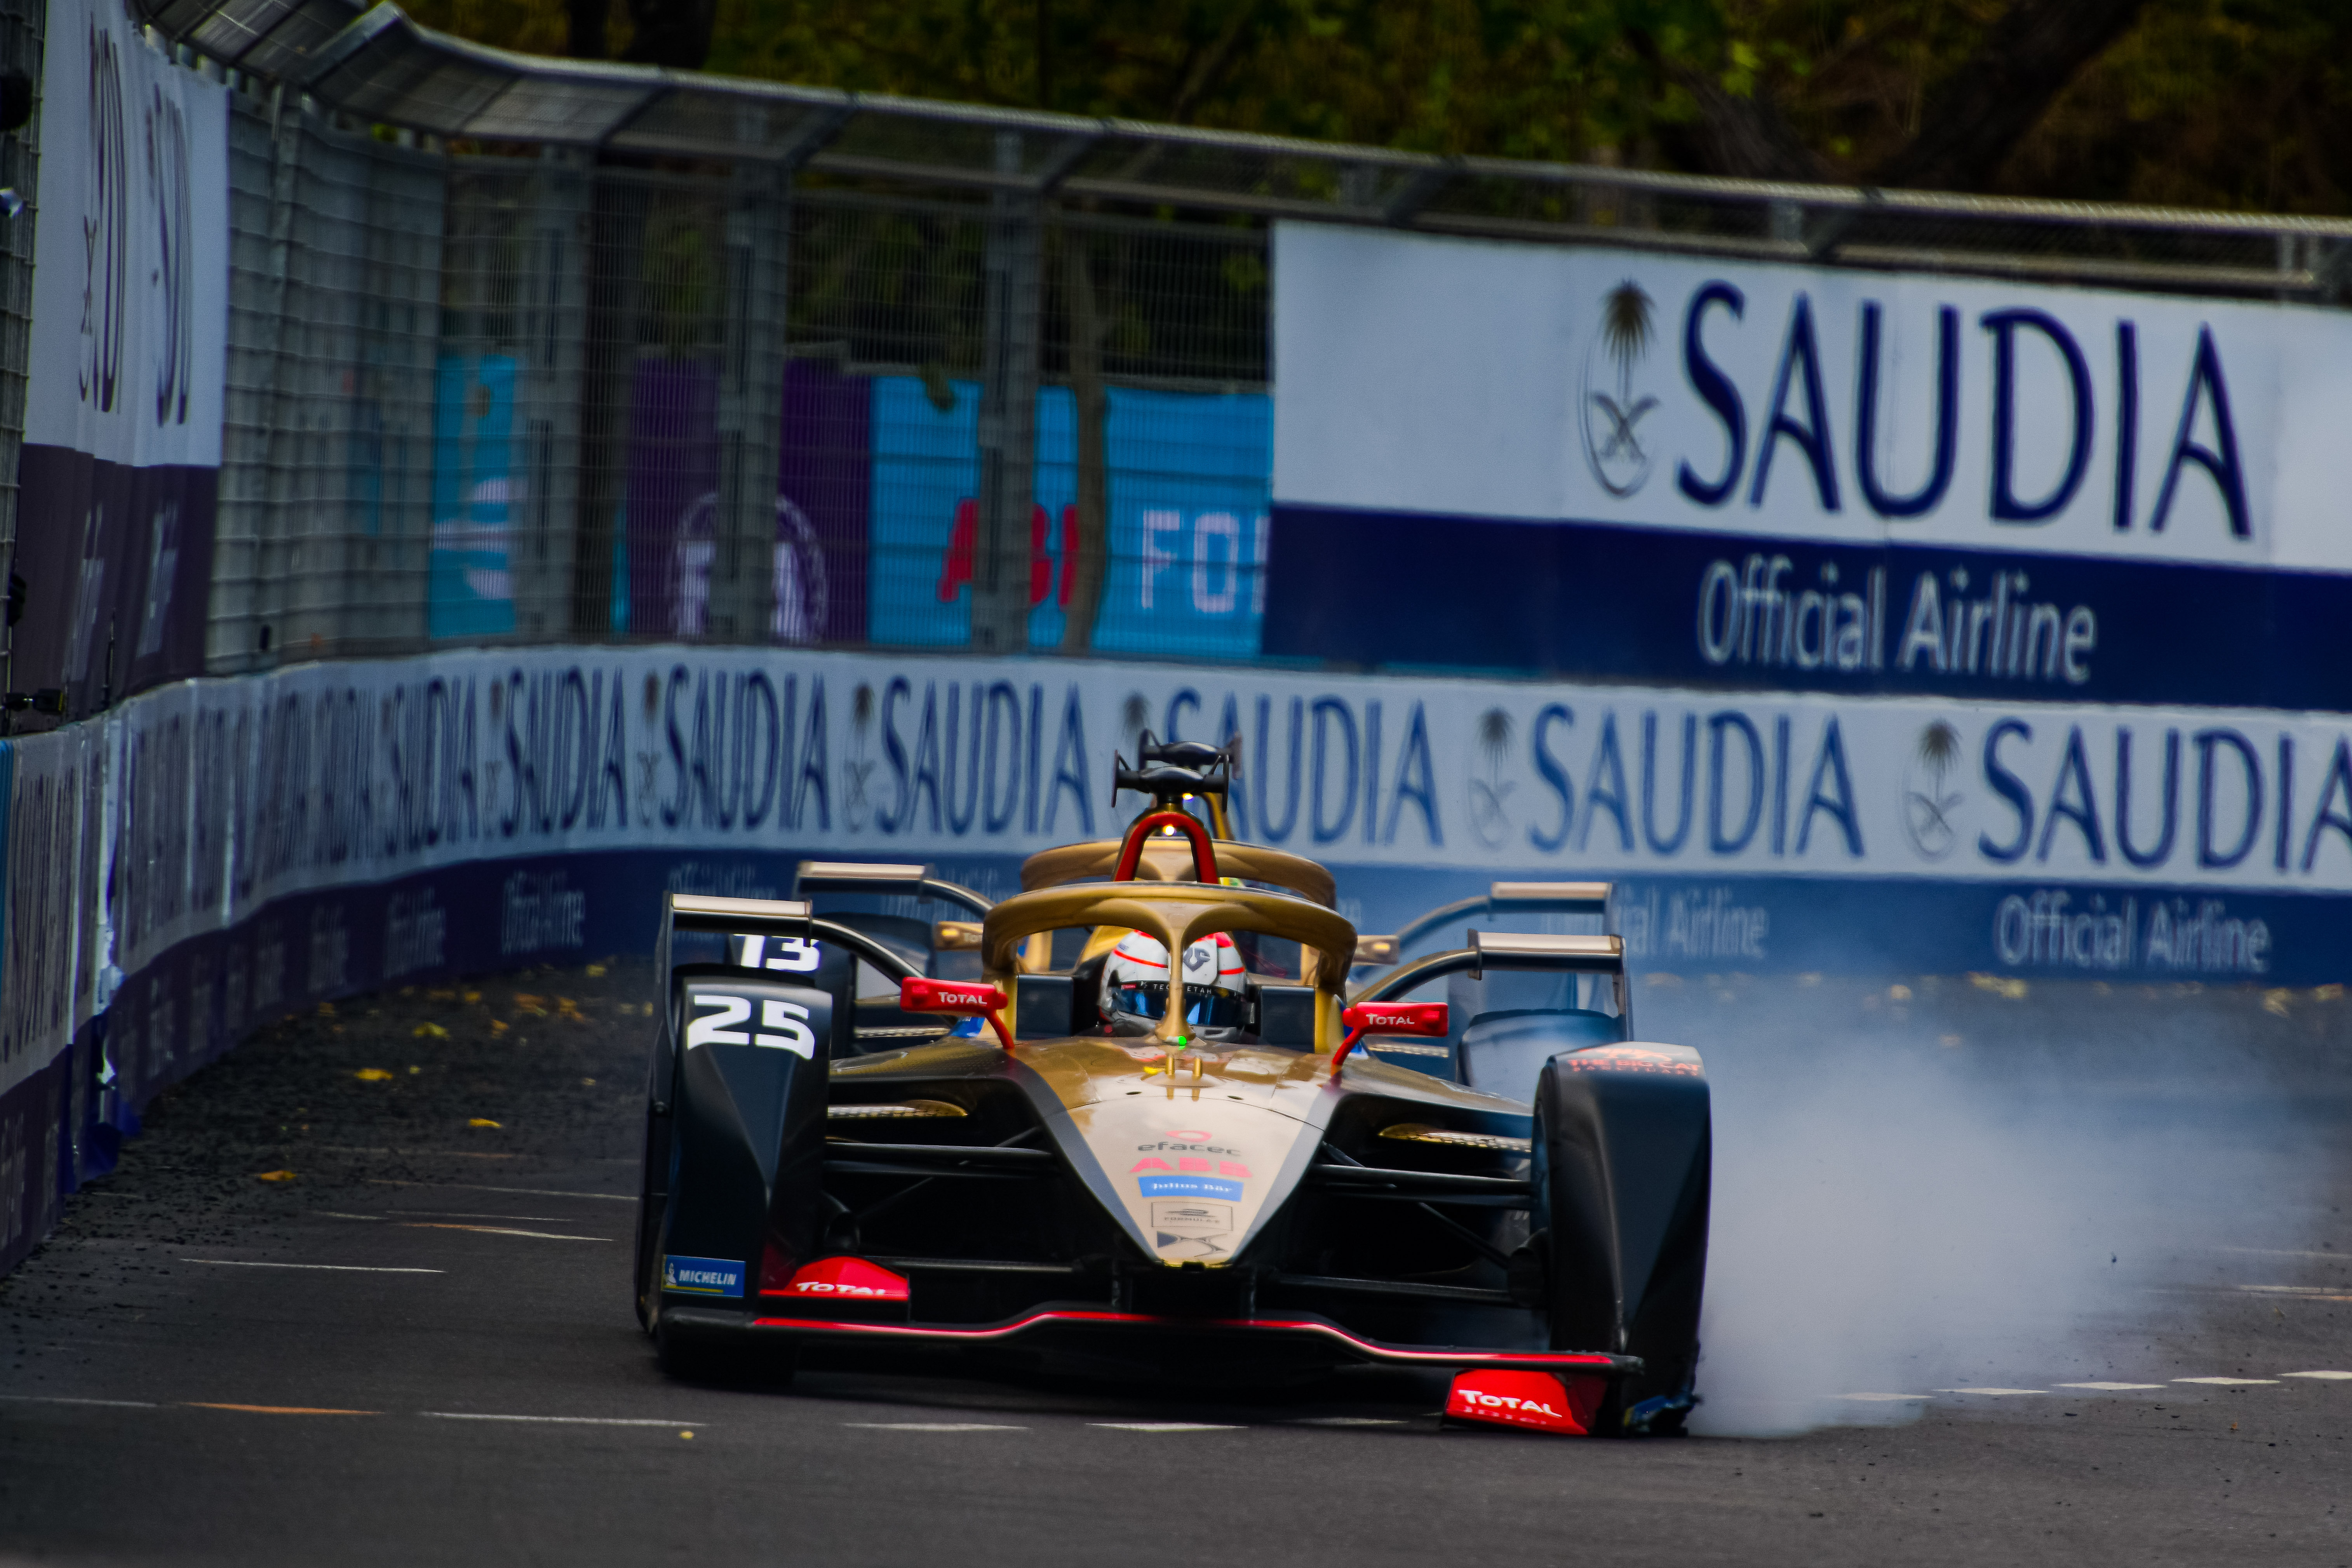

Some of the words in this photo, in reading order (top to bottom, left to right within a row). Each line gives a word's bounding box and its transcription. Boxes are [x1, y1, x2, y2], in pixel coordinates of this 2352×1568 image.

[1675, 278, 2252, 539] SAUDIA
[1698, 553, 1886, 671] Official
[1896, 568, 2097, 684] Airline
[662, 663, 830, 833] SAUDIA
[876, 675, 1095, 835] SAUDIA
[1526, 701, 1865, 858] SAUDIA
[1978, 715, 2352, 874] SAUDIA
[963, 933, 983, 943] TO
[1670, 888, 1770, 959] Airline
[1997, 889, 2138, 969] Official
[2146, 895, 2271, 973] Airline
[733, 933, 821, 971] 13
[938, 992, 987, 1005] TOTAL
[1153, 984, 1212, 994] TECETAH
[687, 995, 815, 1060] 25
[1366, 1013, 1415, 1025] TOTAL
[1137, 1141, 1241, 1156] efacec
[1130, 1157, 1253, 1178] ABB
[679, 1269, 736, 1285] MICHELIN
[1458, 1389, 1563, 1418] TOTAL
